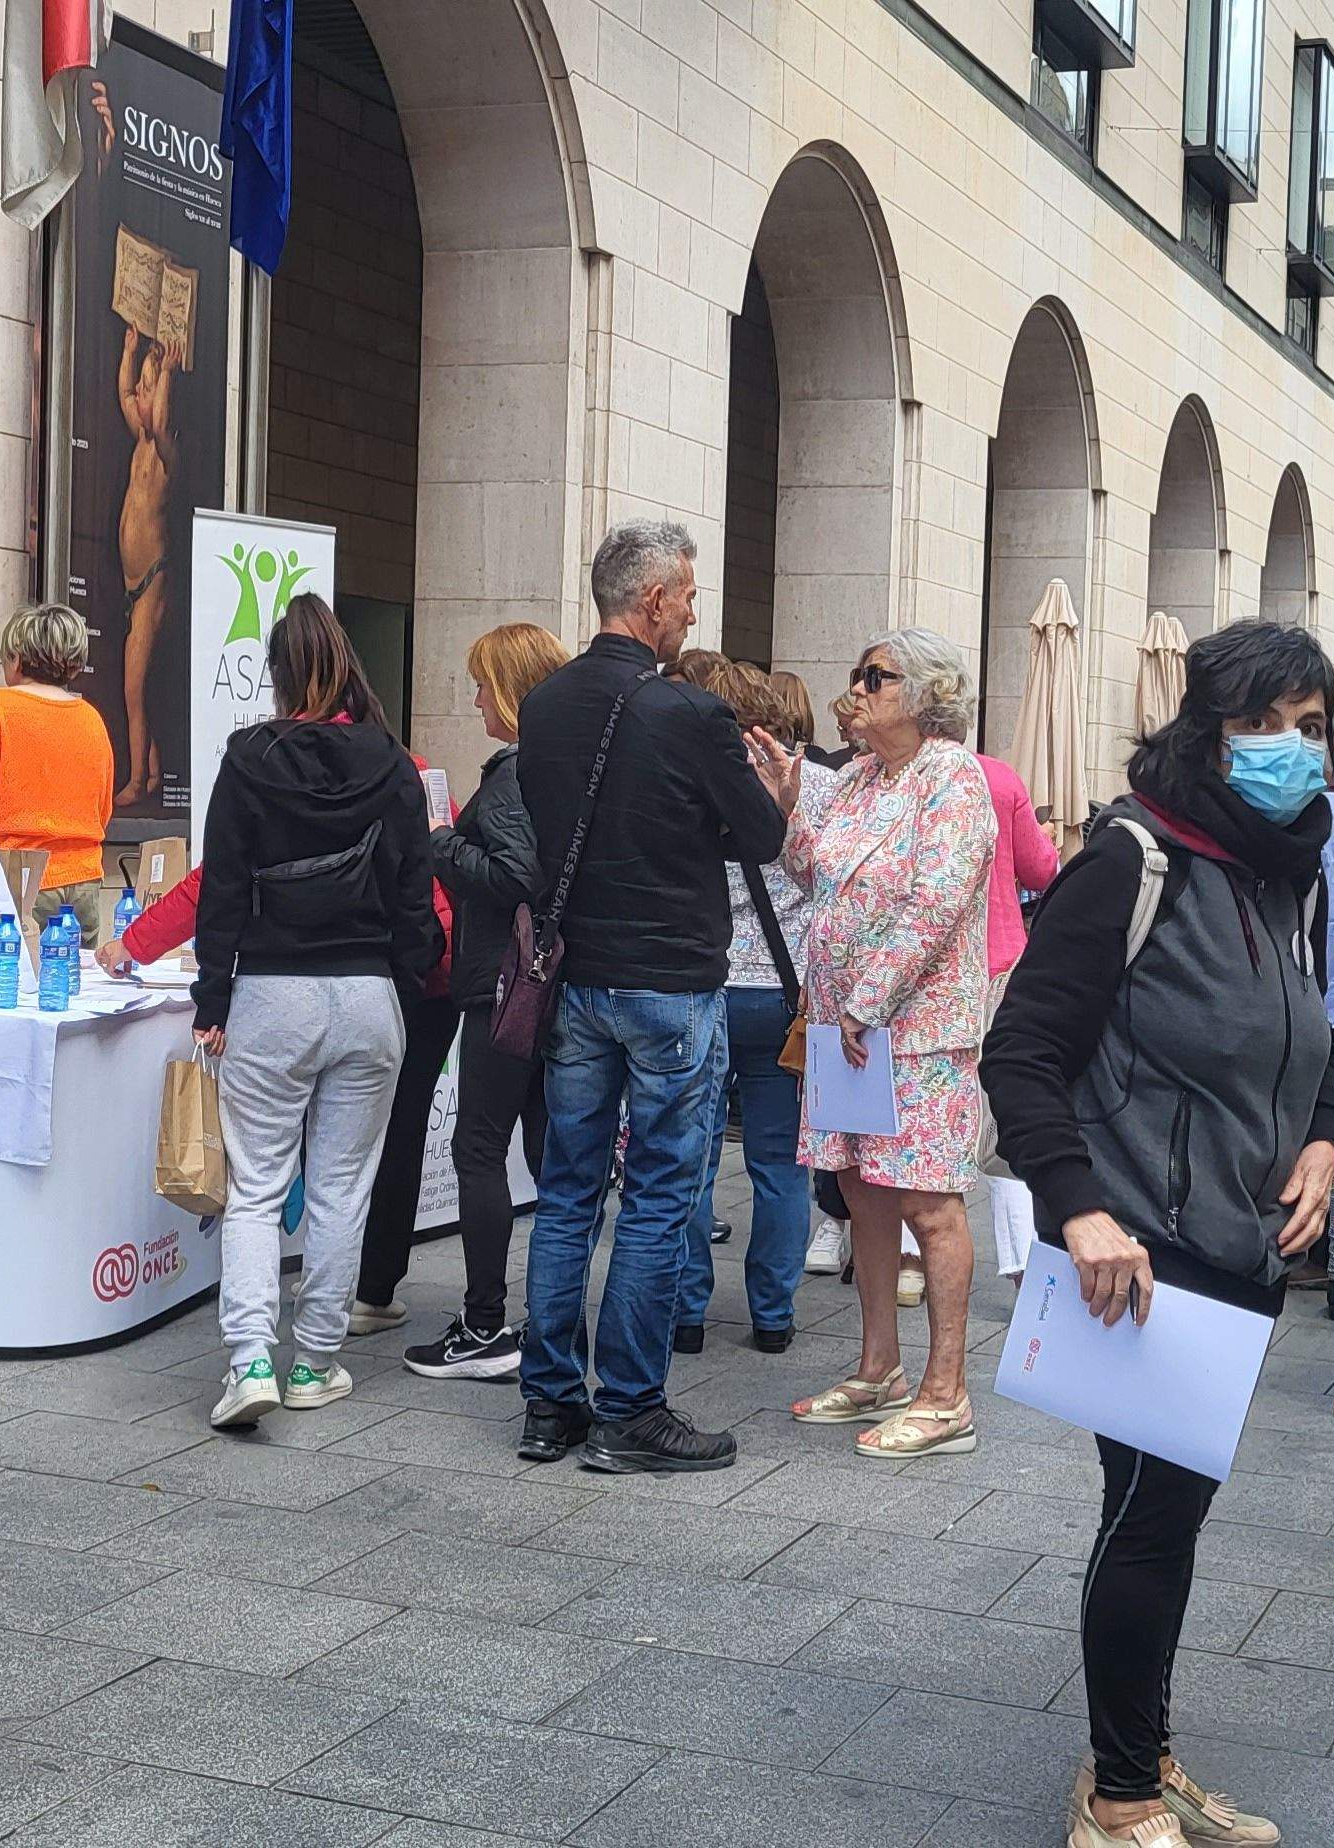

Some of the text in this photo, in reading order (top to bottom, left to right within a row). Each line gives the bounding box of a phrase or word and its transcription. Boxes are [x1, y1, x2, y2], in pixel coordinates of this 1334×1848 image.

[124, 105, 223, 181] SIGNOS
[212, 653, 274, 702] ASA
[586, 693, 624, 797] JAMES DEAN
[549, 817, 586, 921] JAMES DEAN
[425, 1138, 452, 1162] HUE
[142, 1246, 179, 1284] ONCE
[143, 1228, 179, 1257] Fundación
